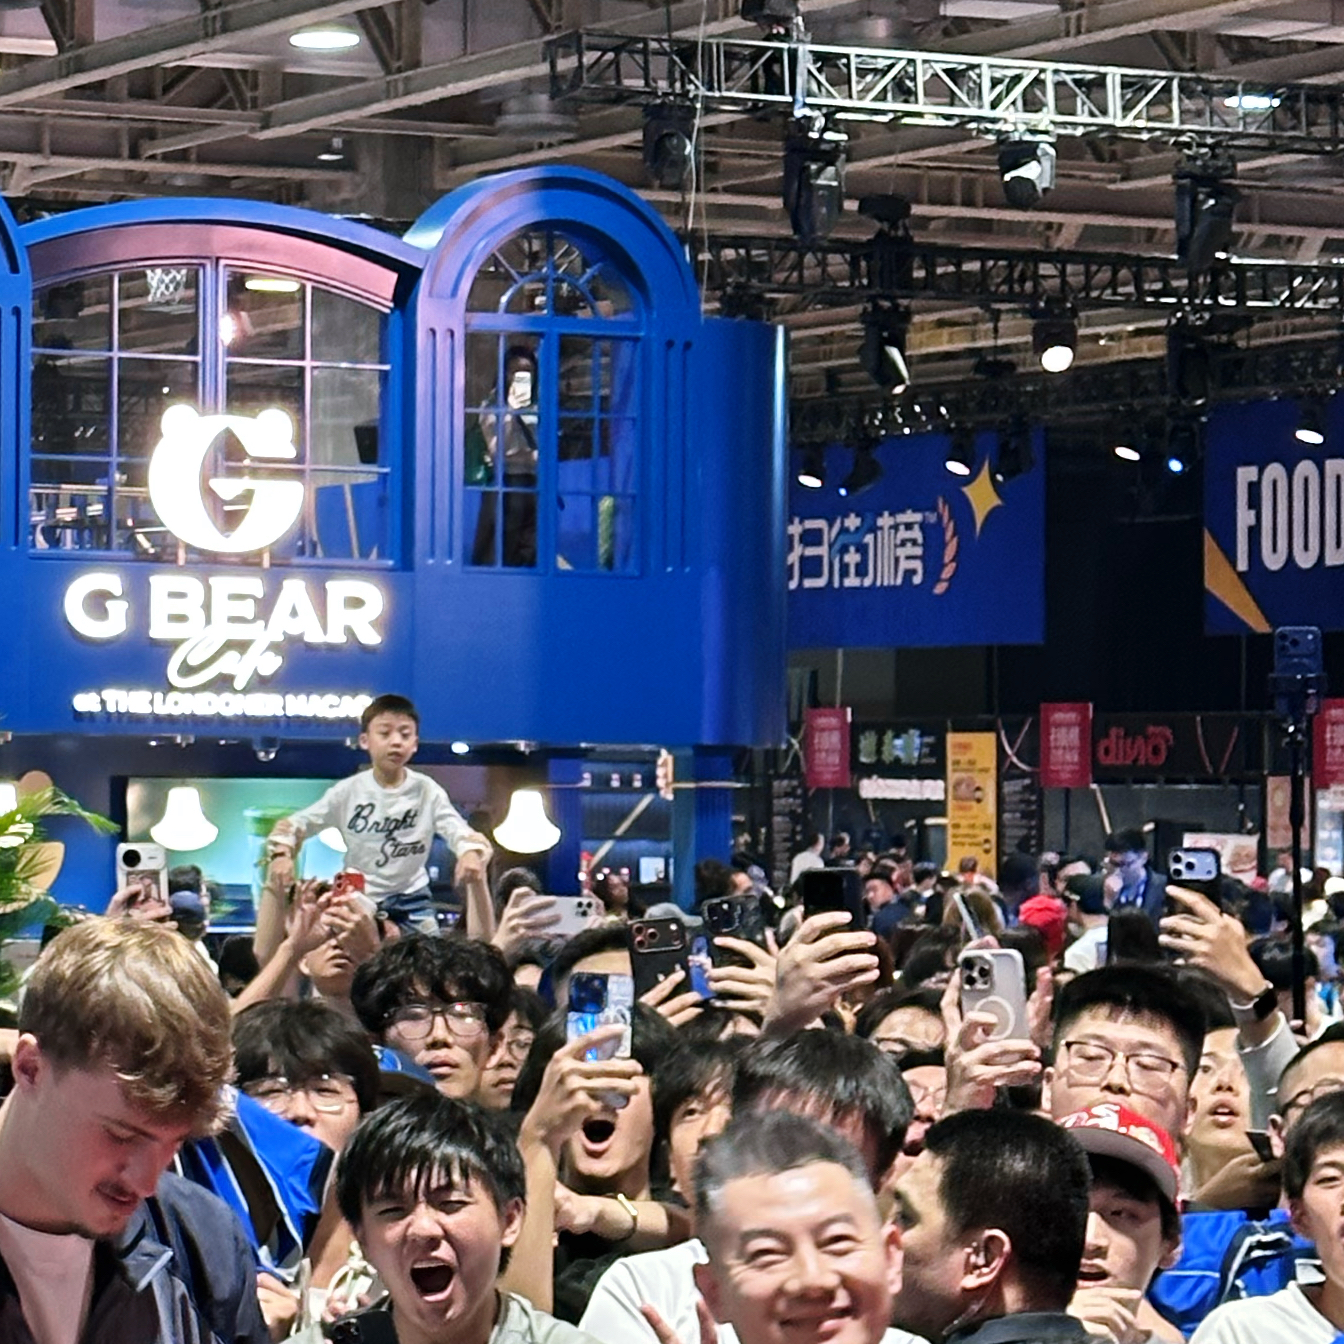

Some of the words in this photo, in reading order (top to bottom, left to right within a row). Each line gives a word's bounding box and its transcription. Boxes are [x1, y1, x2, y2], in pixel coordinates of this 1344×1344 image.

[787, 509, 924, 591] 扫街榜
[1236, 457, 1344, 572] FOOD
[64, 572, 129, 638] G
[149, 574, 383, 645] BEAR
[347, 802, 419, 837] Bright
[375, 837, 426, 867] Stars
